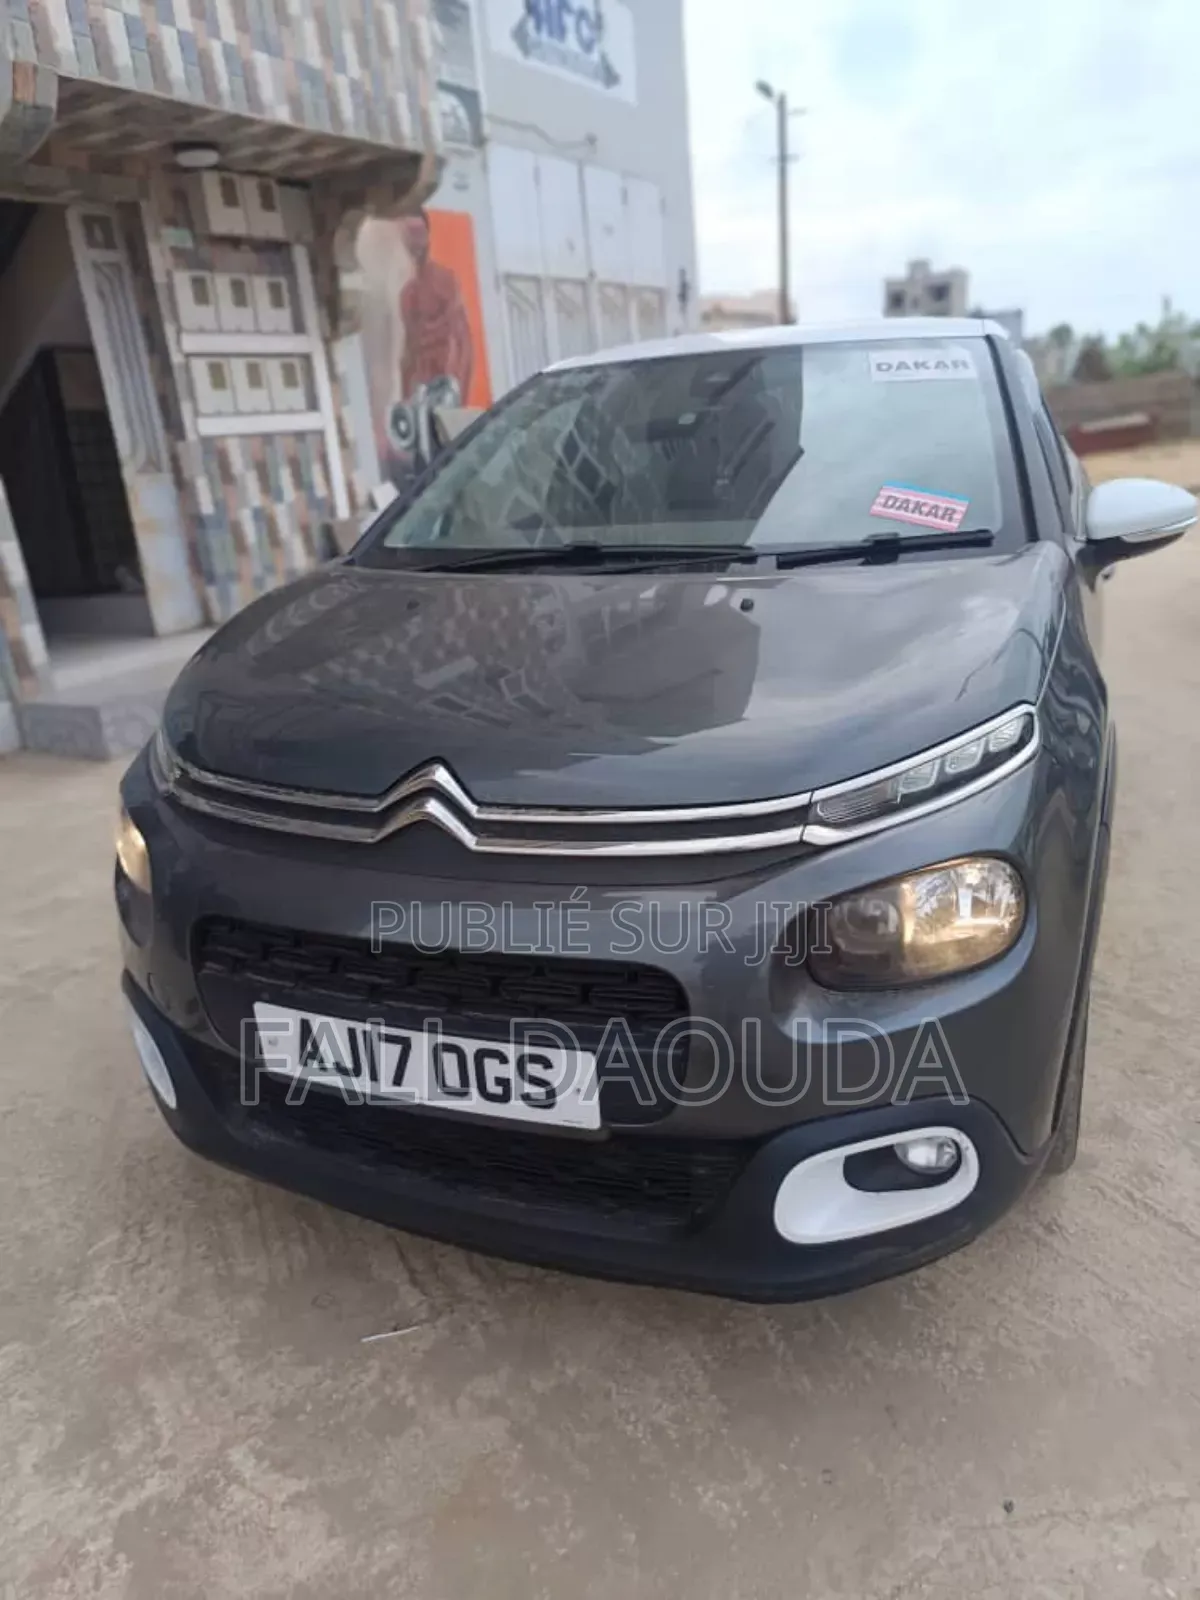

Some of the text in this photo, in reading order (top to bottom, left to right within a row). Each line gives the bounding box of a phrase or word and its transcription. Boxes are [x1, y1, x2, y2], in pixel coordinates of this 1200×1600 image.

[875, 359, 970, 372] DAKAR
[881, 495, 959, 523] DAKAR
[299, 1018, 412, 1087] AJ17
